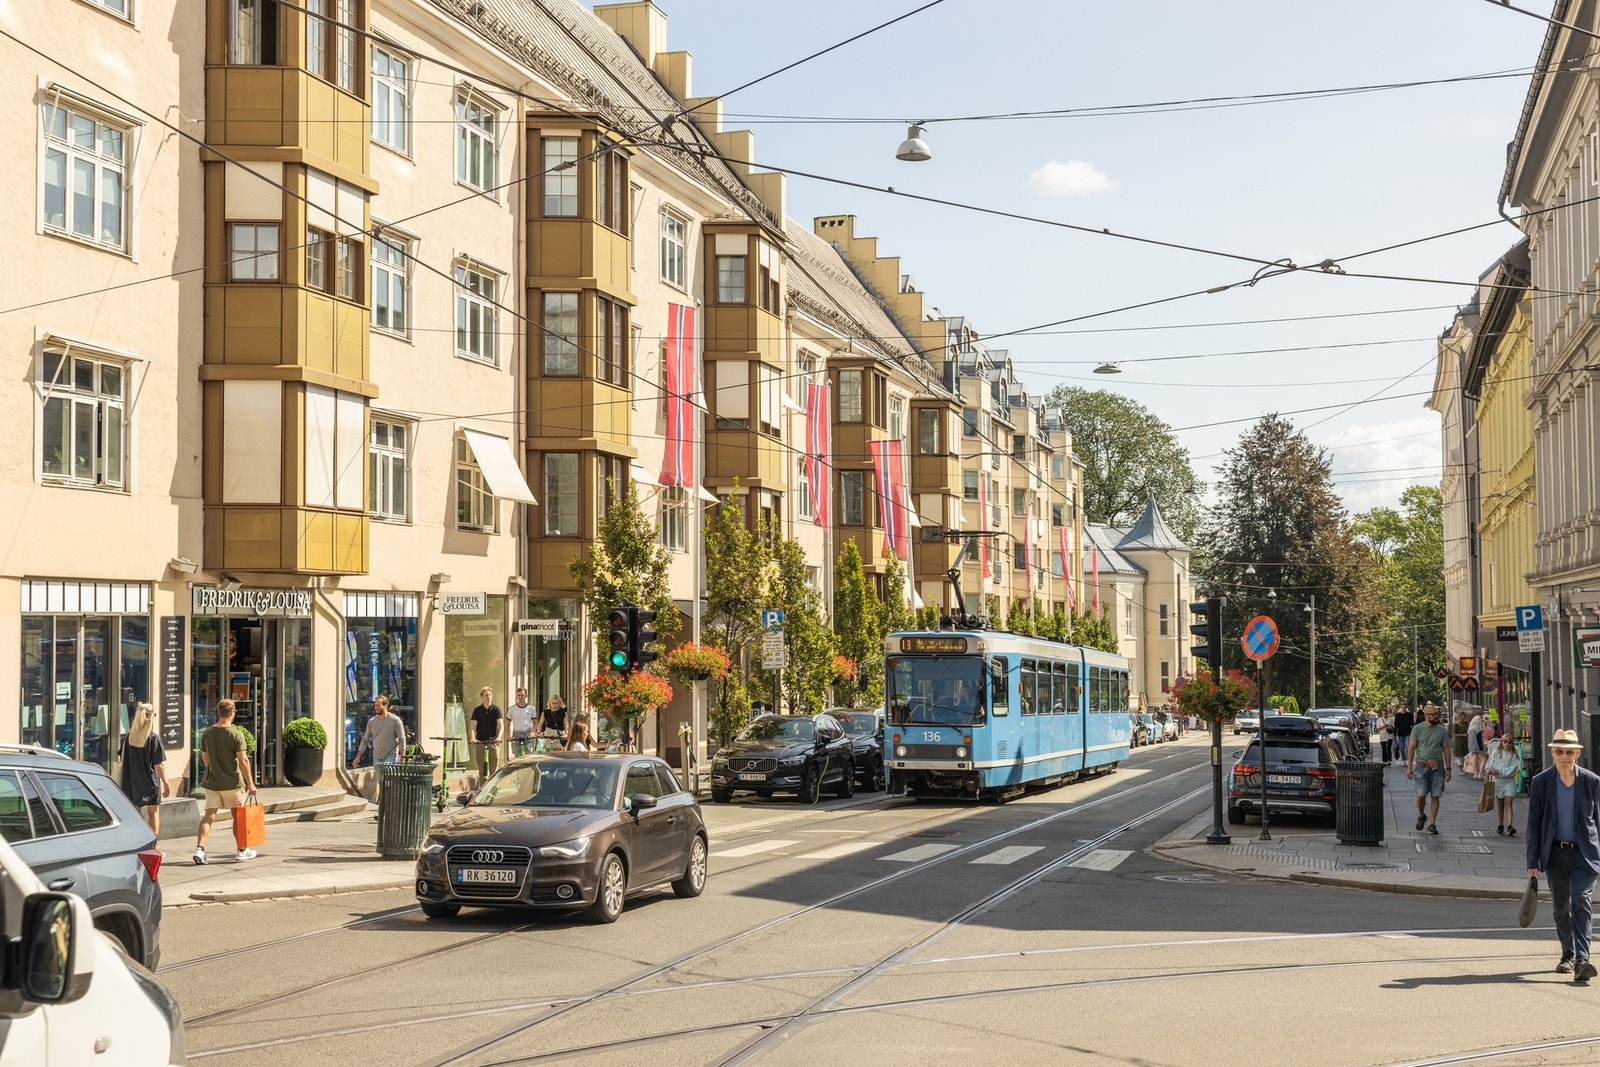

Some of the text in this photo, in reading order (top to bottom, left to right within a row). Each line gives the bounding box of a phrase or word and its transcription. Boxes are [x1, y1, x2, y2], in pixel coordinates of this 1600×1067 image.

[442, 602, 480, 612] &LOUISA
[1521, 609, 1536, 628] P
[520, 622, 555, 631] ginatricot
[1587, 646, 1600, 654] MI
[923, 731, 941, 742] 136
[467, 871, 513, 881] RK 36120
